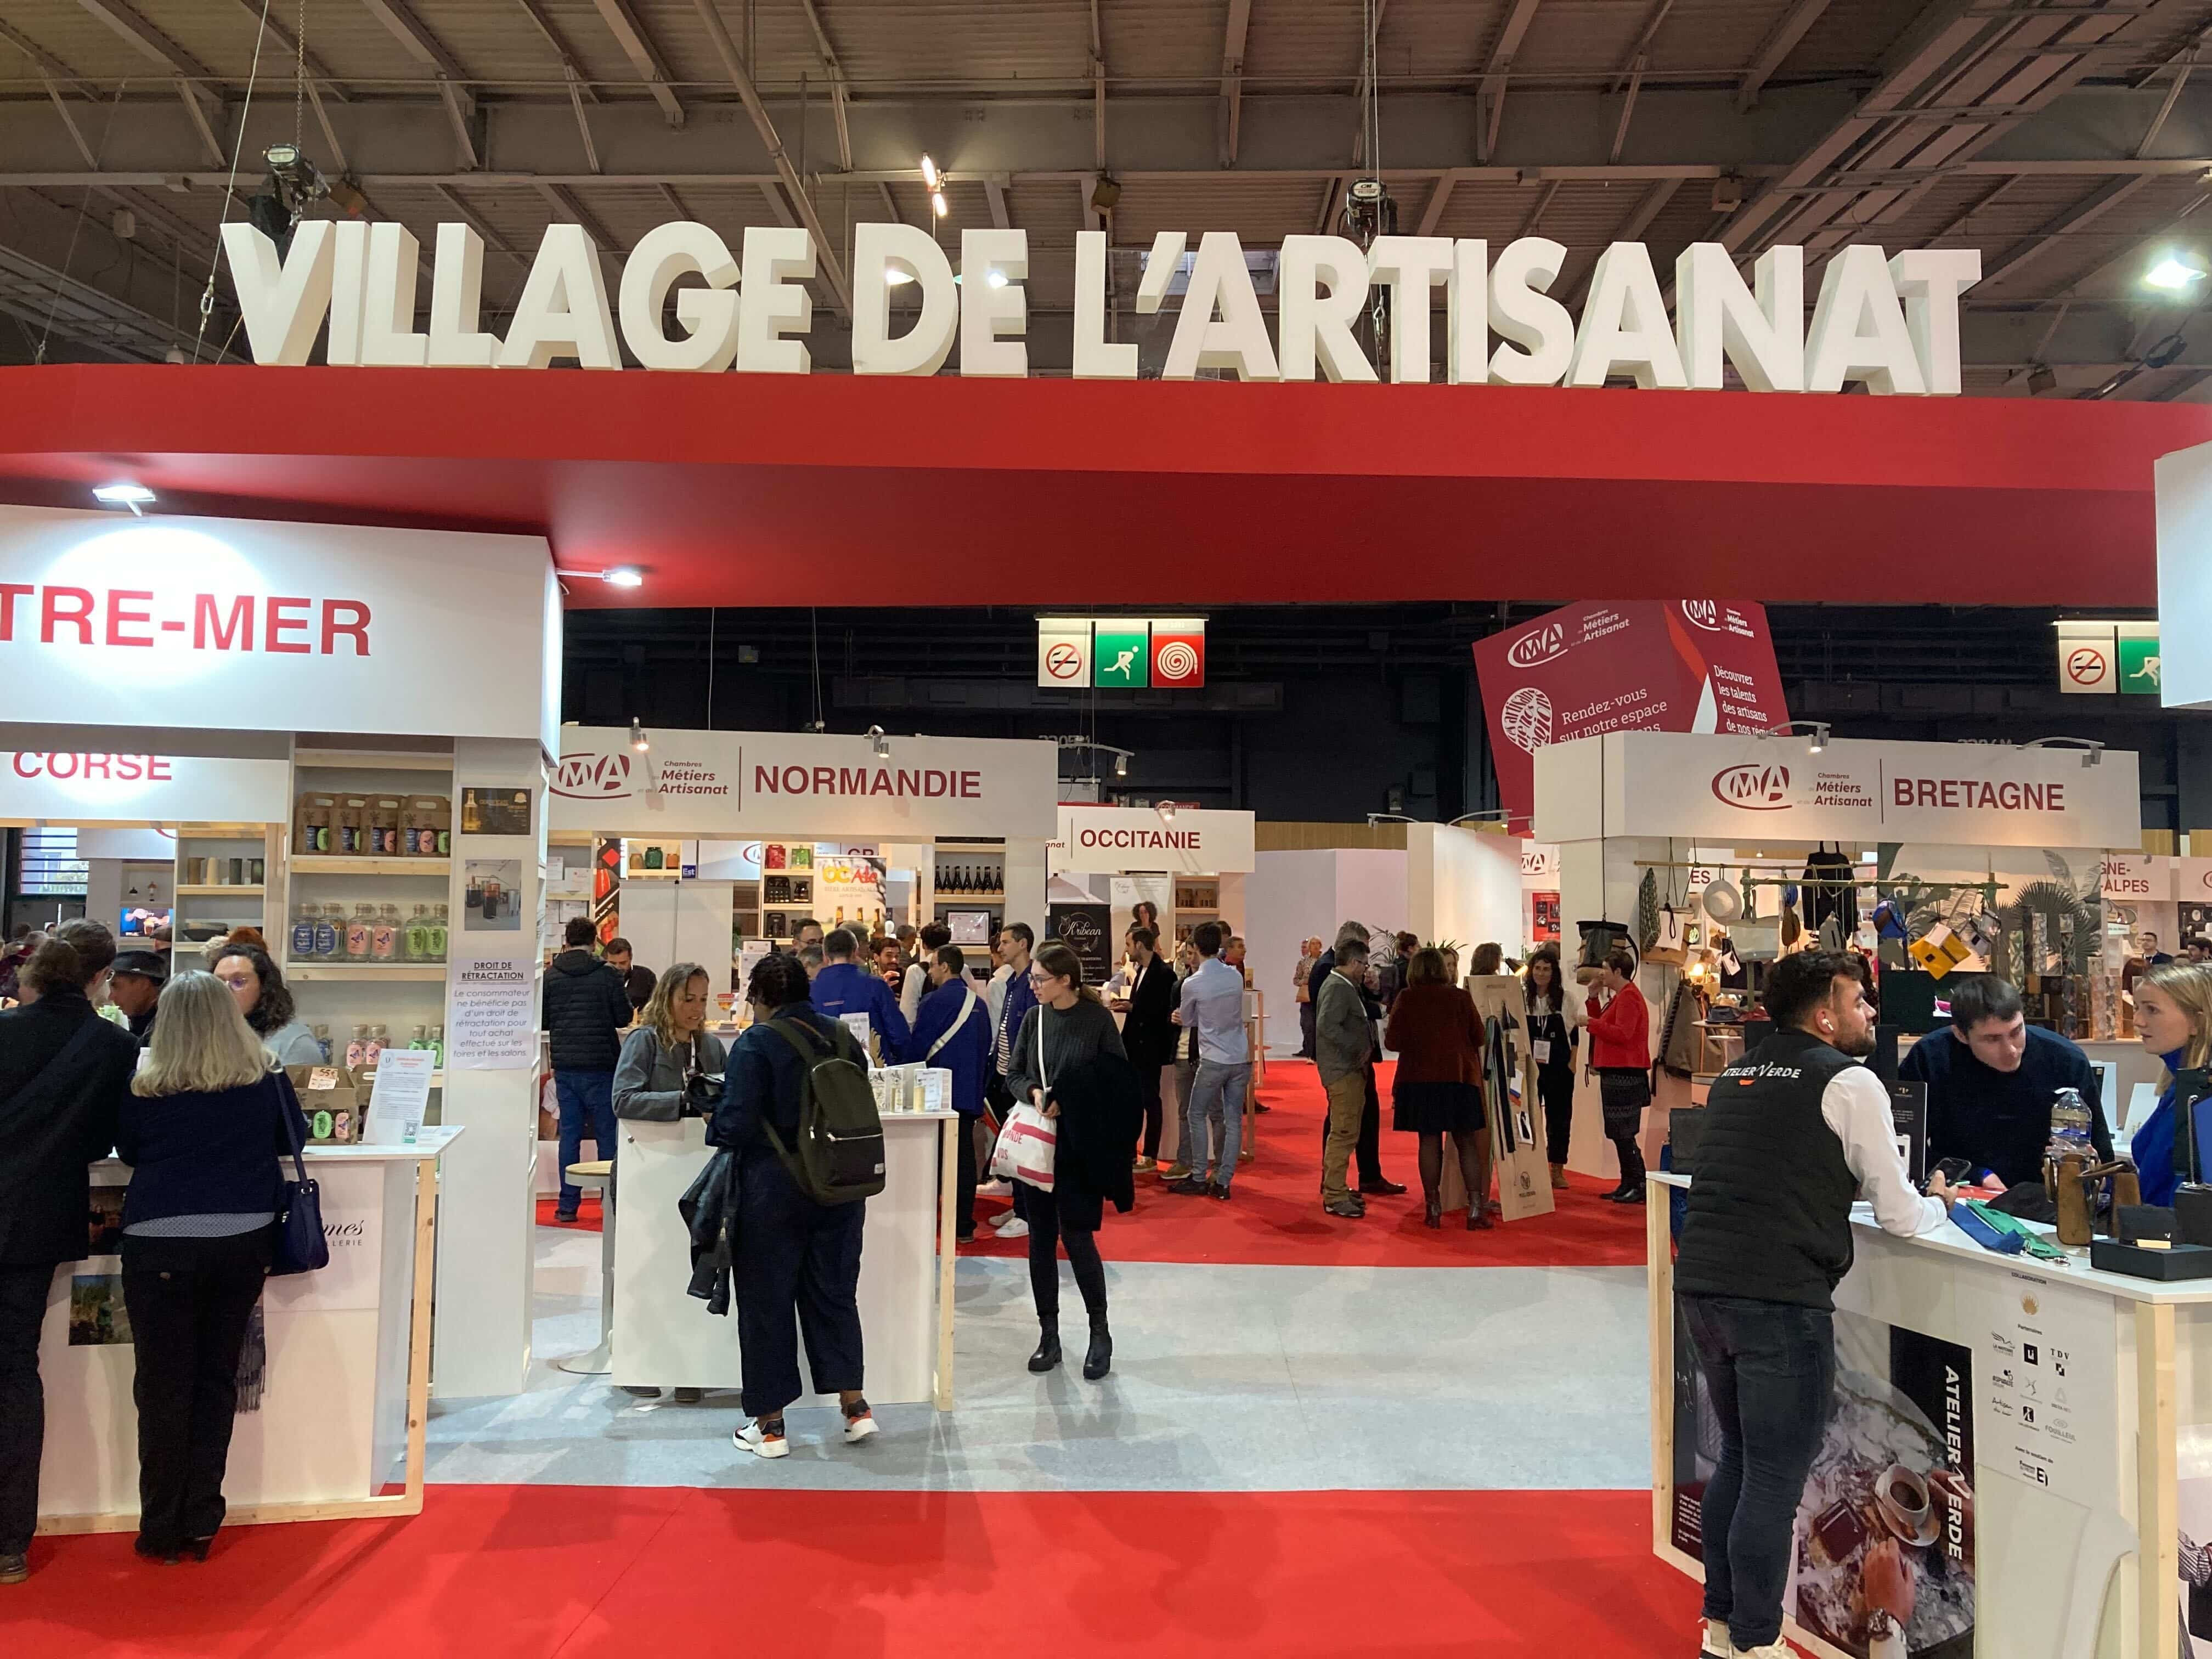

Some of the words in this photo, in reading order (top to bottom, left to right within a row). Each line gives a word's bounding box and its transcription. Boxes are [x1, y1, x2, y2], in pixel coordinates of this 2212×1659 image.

[221, 220, 816, 374] VILLAGE
[852, 222, 1028, 379] DE
[1073, 230, 1982, 397] L'ARTISANAT
[0, 583, 371, 656] TRE-MER
[1583, 613, 1620, 632] Métiers
[1584, 618, 1630, 642] Artisanat
[1713, 664, 1754, 686] Découvrez
[1717, 681, 1730, 696] les
[1730, 686, 1757, 703] talents
[1562, 688, 1647, 725] Rendez-vous
[1723, 700, 1736, 715] des
[1736, 706, 1768, 722] artisans
[1559, 729, 1580, 742] sur
[1583, 718, 1618, 737] notre
[1621, 701, 1668, 723] espace
[1726, 718, 1736, 732] de
[1736, 724, 1752, 735] nos
[13, 752, 172, 781] CORSE
[661, 769, 716, 781] Métiers
[658, 782, 729, 795] Artisanat
[755, 765, 981, 798] NORMANDIE
[1816, 781, 1861, 793] Métiers
[1814, 795, 1872, 807] Artisanat
[1894, 778, 2065, 811] BRETAGNE
[1080, 829, 1201, 849] OCCITANIE
[682, 867, 695, 876] Est
[461, 970, 523, 980] RÉTRACTATION
[511, 1000, 527, 1008] pas
[456, 1019, 505, 1028] rétractation
[507, 1019, 527, 1028] pour
[511, 1039, 523, 1047] les
[1721, 1066, 1757, 1077] ATELIER
[1756, 1061, 1802, 1079] VERDE
[1945, 1365, 1961, 1464] ATELIER
[1948, 1465, 1971, 1560] VERDE
